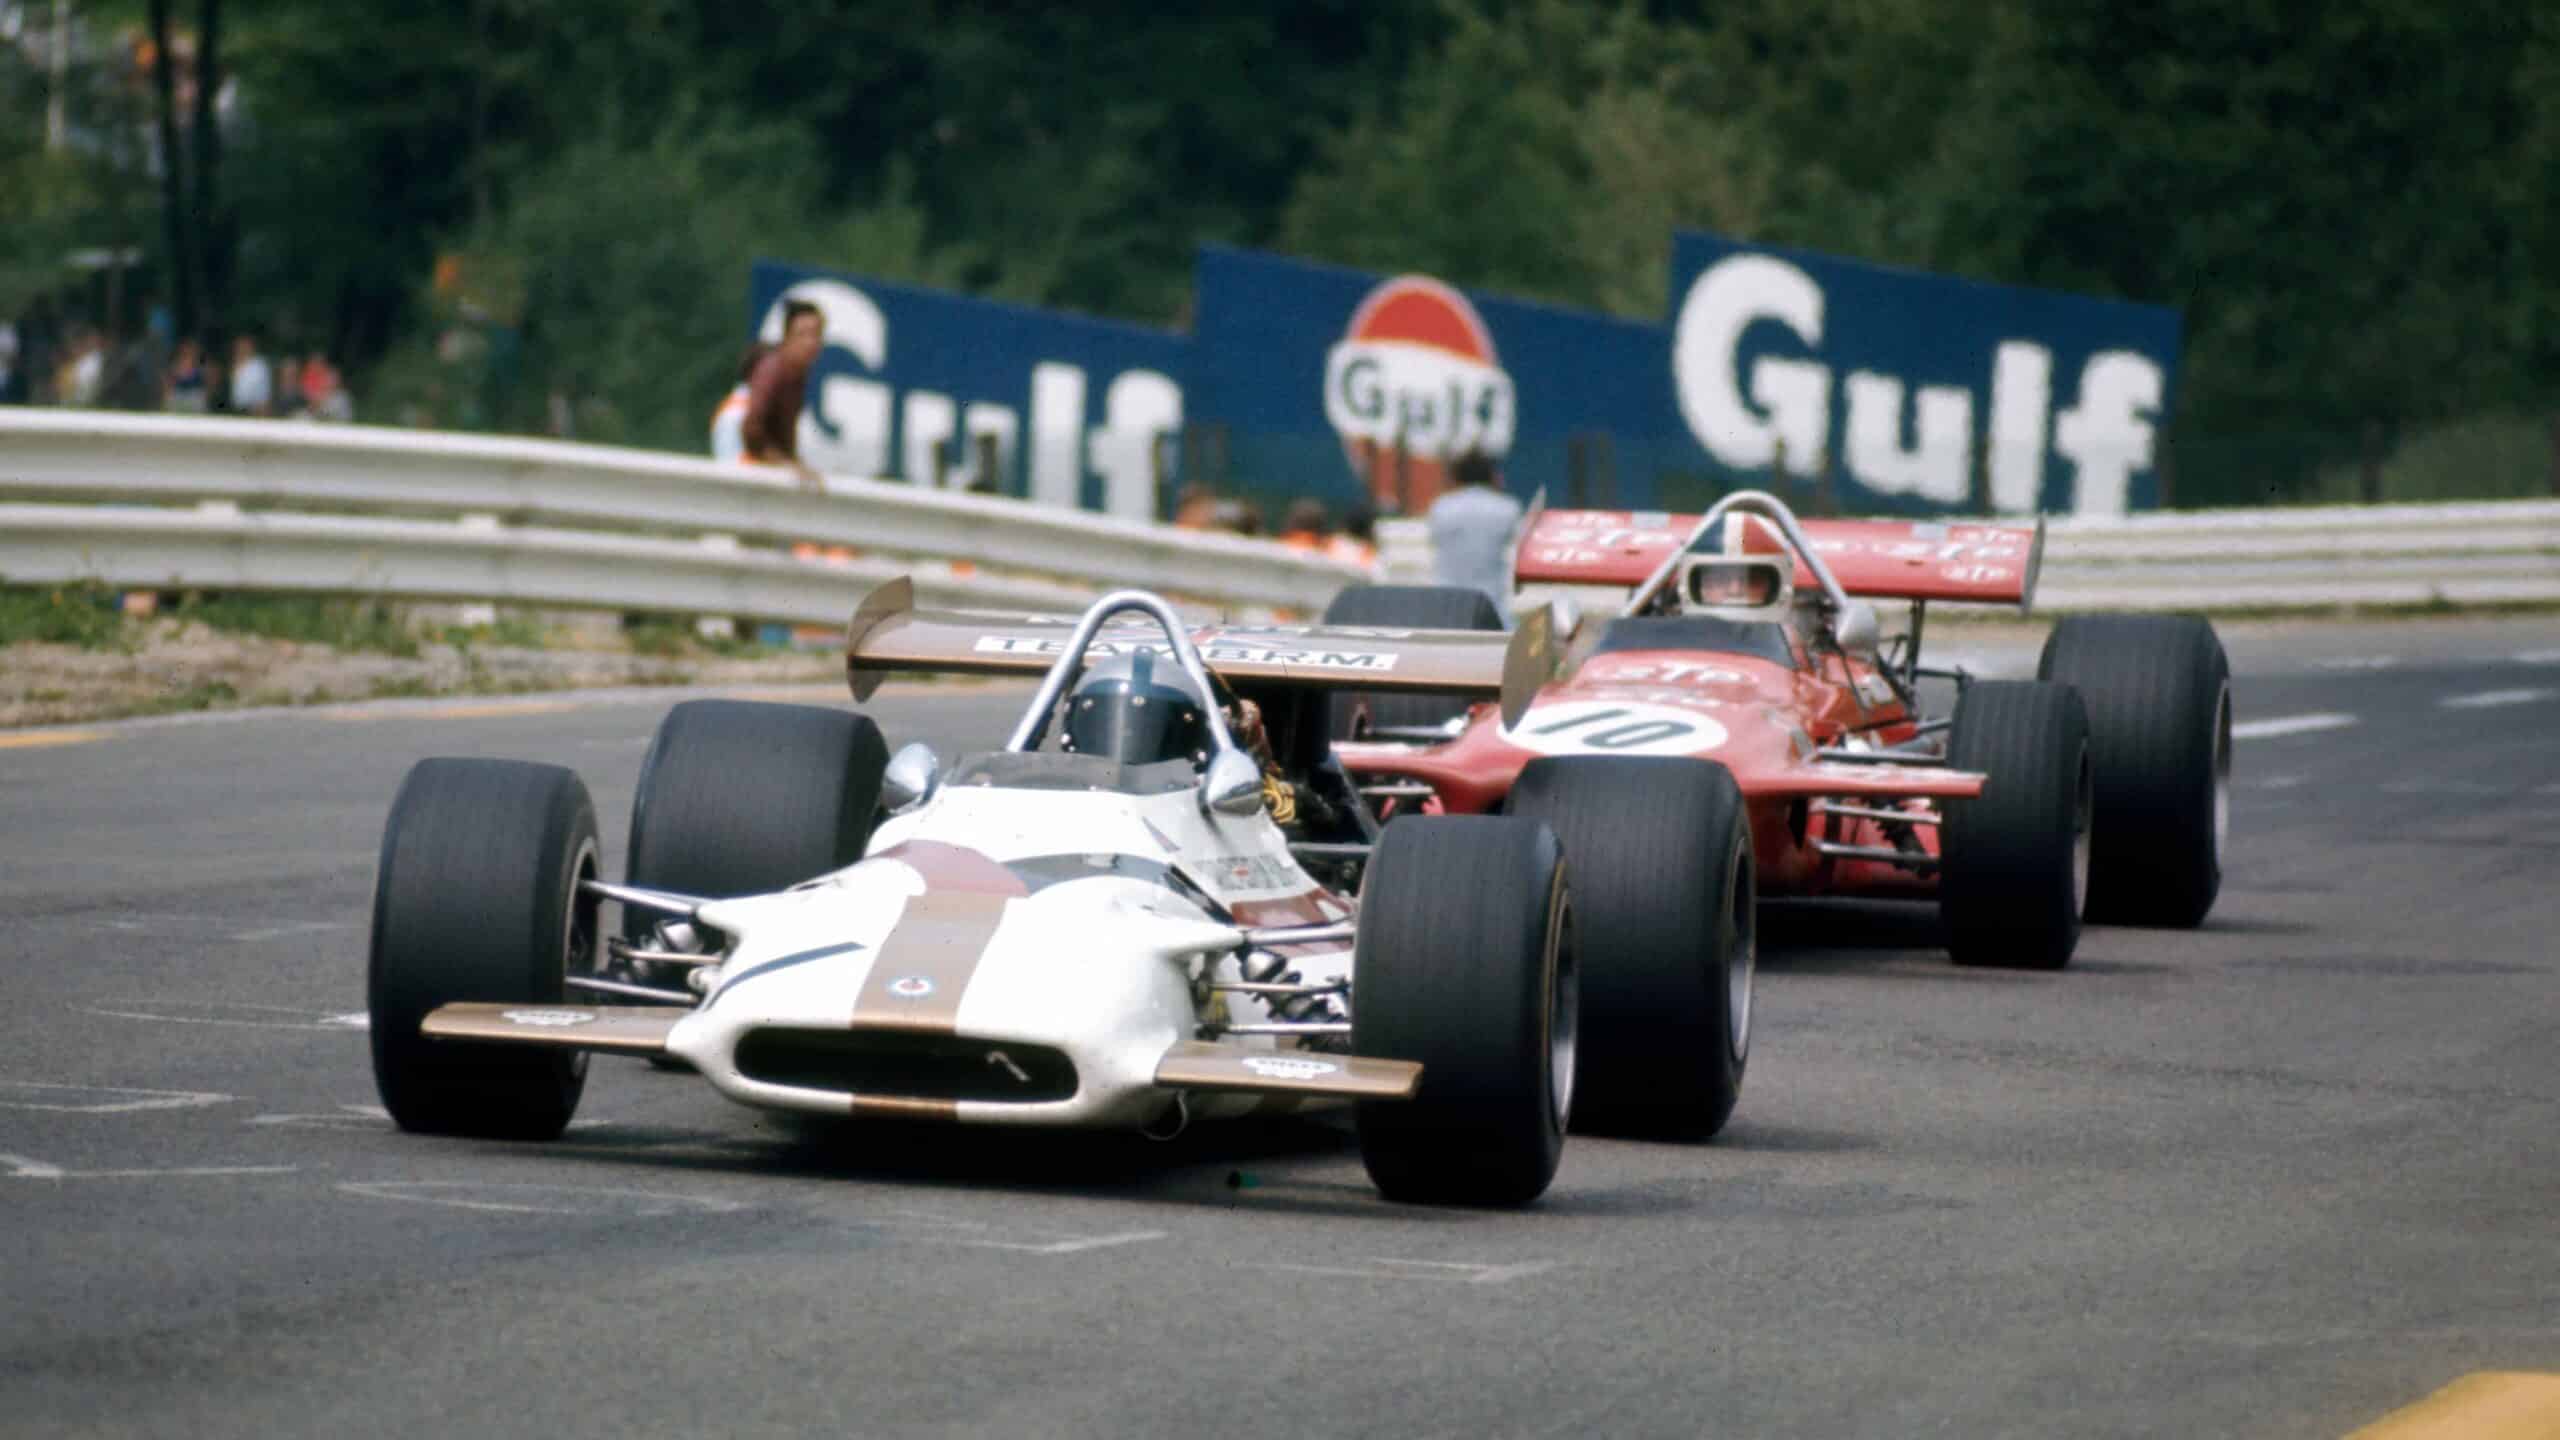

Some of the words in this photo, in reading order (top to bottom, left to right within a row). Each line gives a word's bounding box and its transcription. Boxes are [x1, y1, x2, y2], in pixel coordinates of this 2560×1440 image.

[759, 279, 1184, 521] Gulf
[1341, 356, 1499, 438] Gulf
[1675, 254, 2164, 515] Gulf
[1531, 708, 1697, 749] 10
